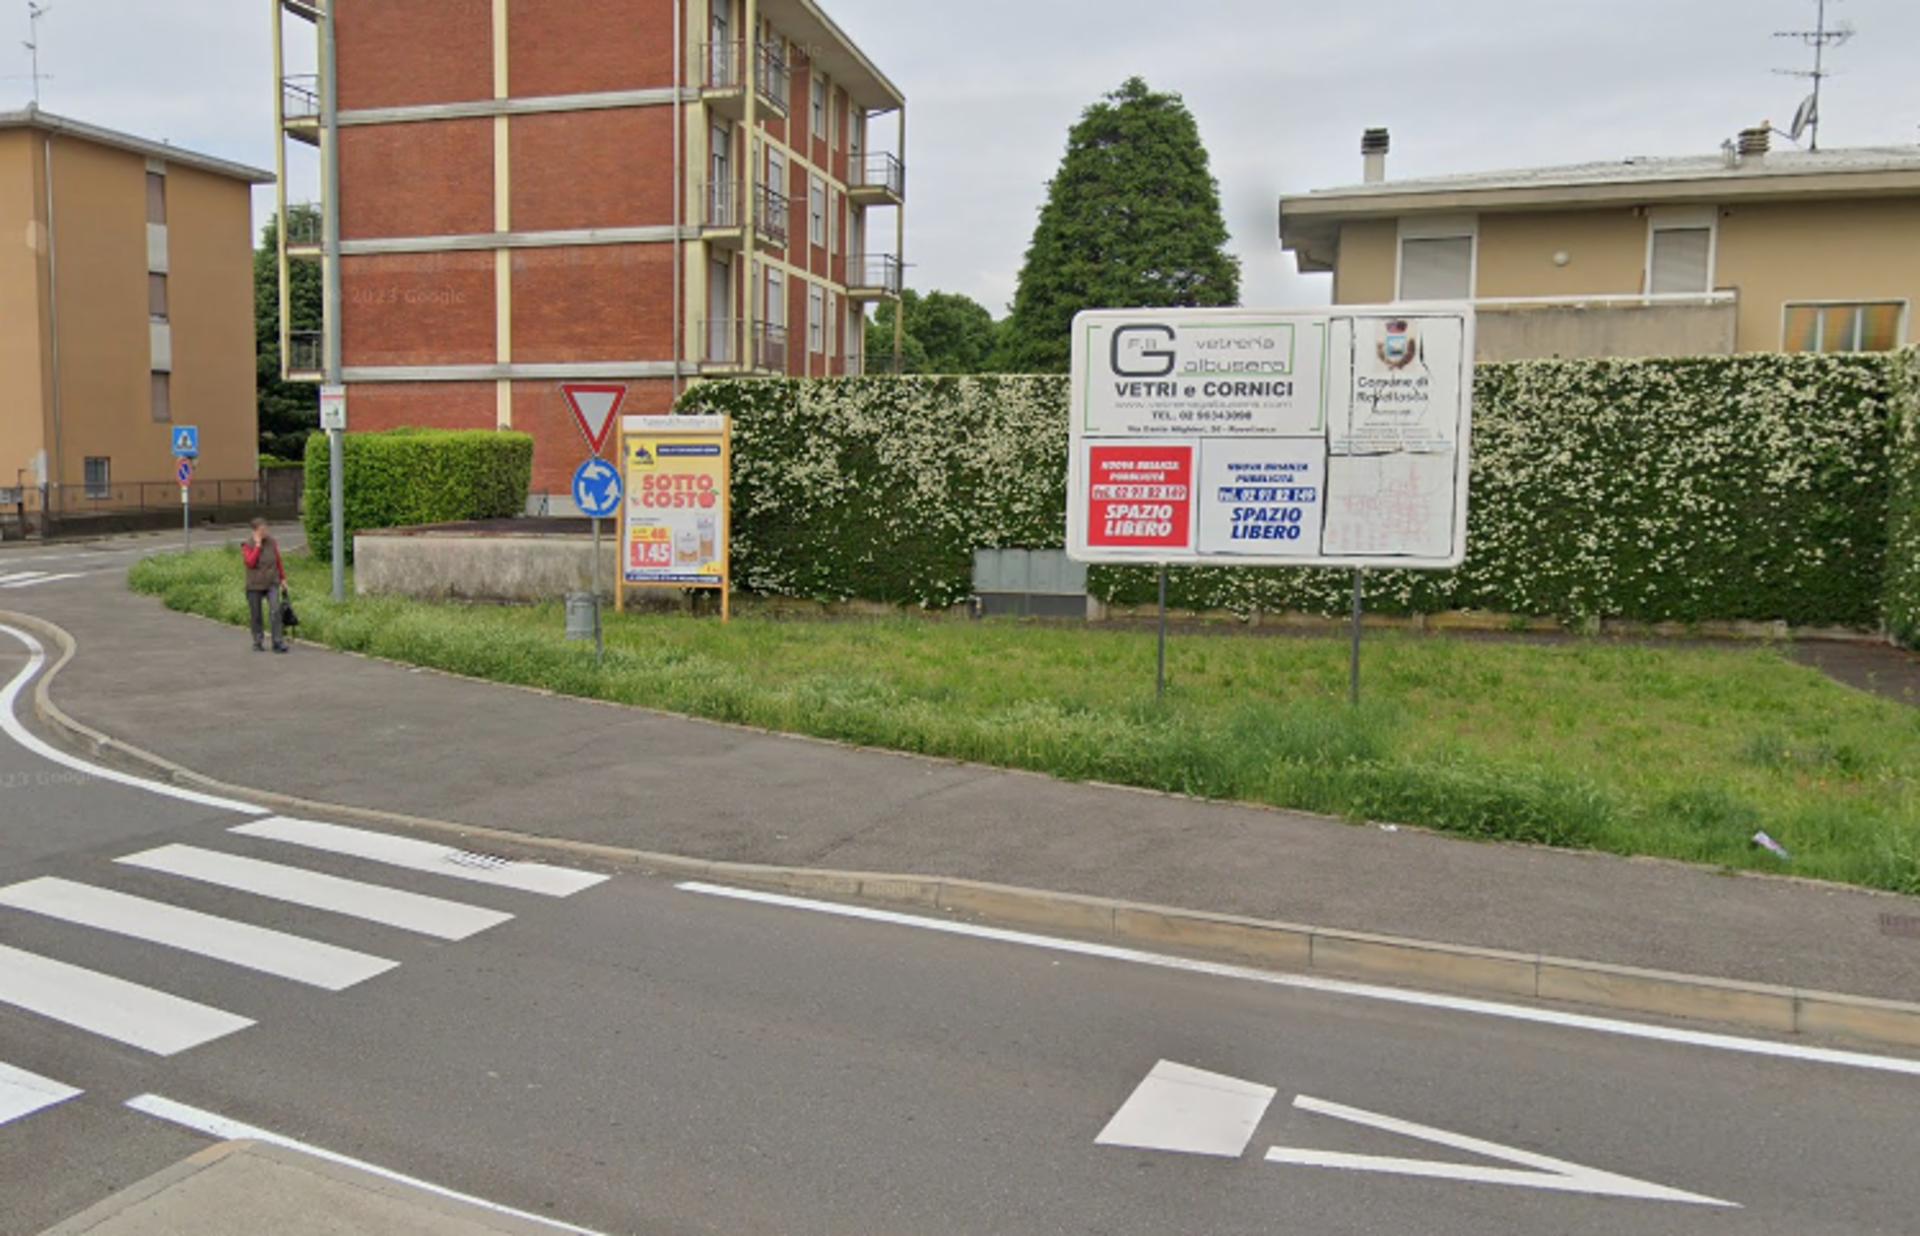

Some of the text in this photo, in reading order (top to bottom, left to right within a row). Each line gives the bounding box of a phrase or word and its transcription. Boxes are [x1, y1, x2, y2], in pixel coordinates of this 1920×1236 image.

[1110, 323, 1176, 377] G
[1195, 338, 1275, 350] vetreria
[1115, 381, 1293, 398] VETRI e CORNICI
[643, 473, 713, 491] SOTTO
[642, 491, 717, 509] COSTO
[1105, 504, 1173, 520] SPAZIO
[1230, 507, 1302, 523] SPAZIO
[1105, 520, 1172, 537] LIBERO
[1231, 525, 1300, 539] LIBERO
